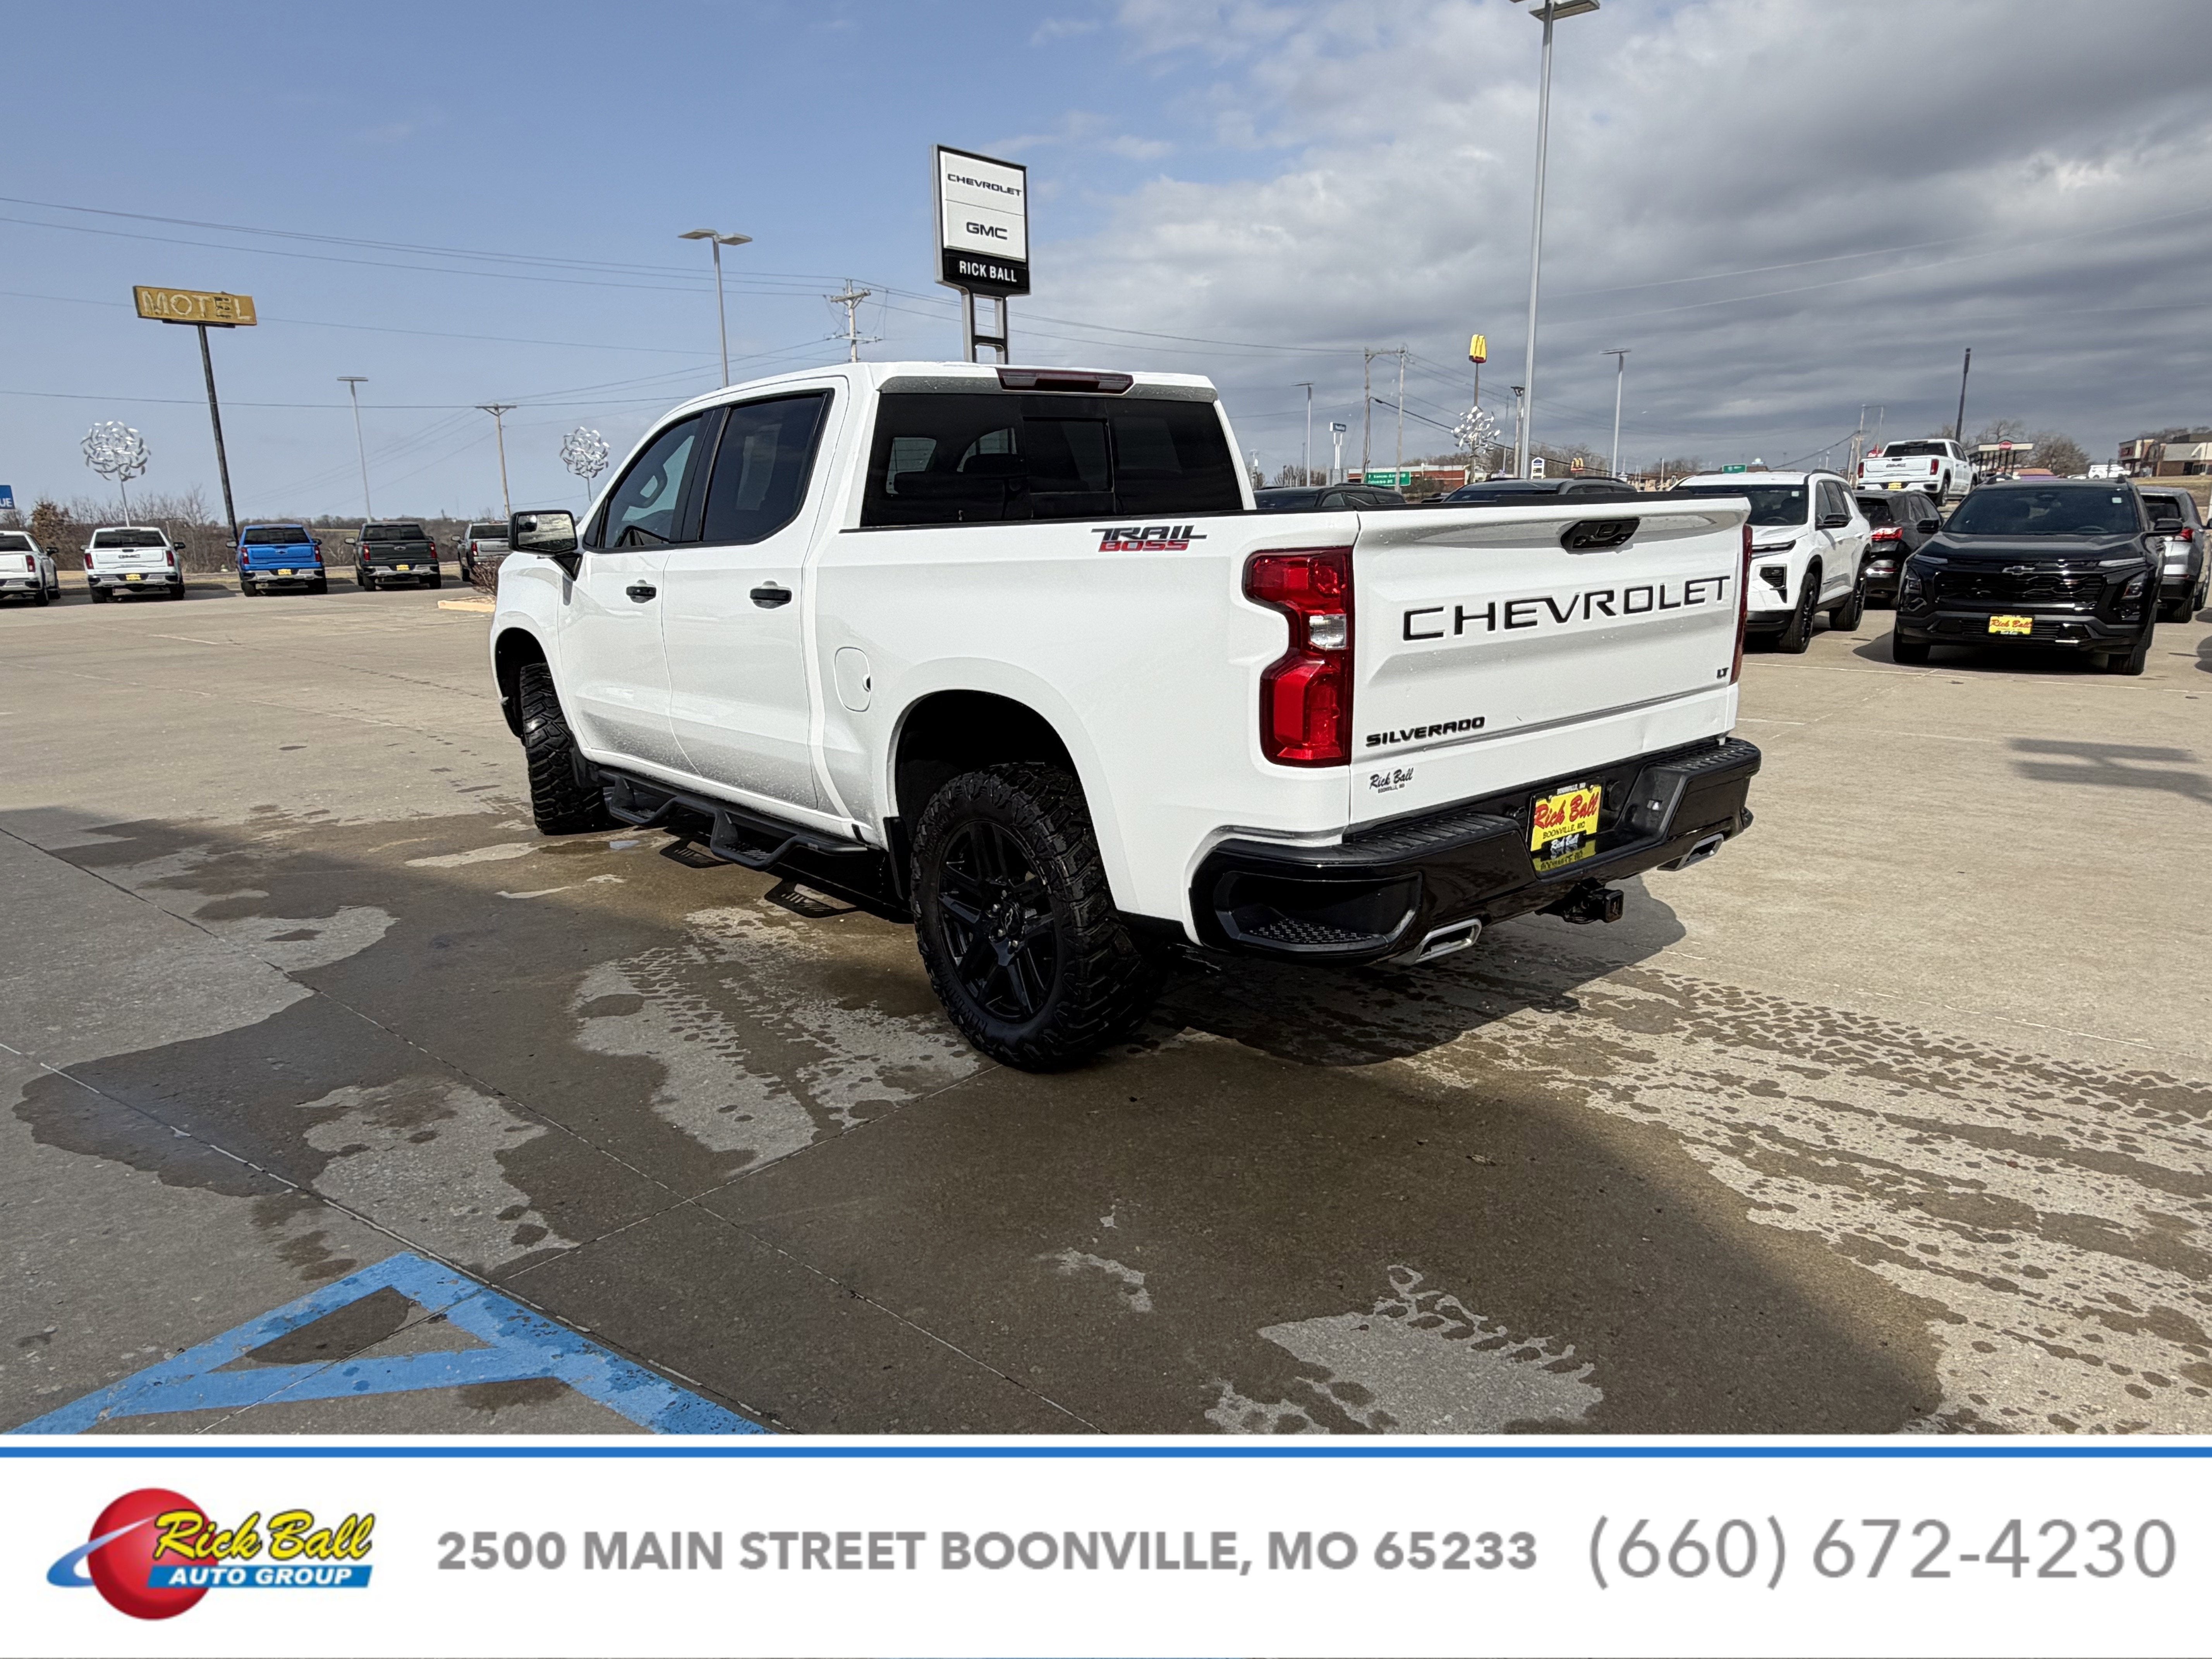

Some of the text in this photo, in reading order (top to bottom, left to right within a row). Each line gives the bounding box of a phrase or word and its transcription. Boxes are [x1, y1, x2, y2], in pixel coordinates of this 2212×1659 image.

[947, 173, 1022, 196] CHEVROLET
[966, 222, 1008, 240] GMC
[959, 261, 1017, 282] RICK BALL
[142, 291, 251, 320] MOTEL
[1091, 525, 1207, 541] TRAIL
[1098, 539, 1190, 552] BOSS
[1403, 575, 1731, 641] CHEVROLET
[1716, 667, 1729, 679] LT
[1365, 716, 1485, 747] SILVERADO
[1369, 767, 1414, 790] Rick Ball
[1534, 792, 1600, 829] Rick Ball
